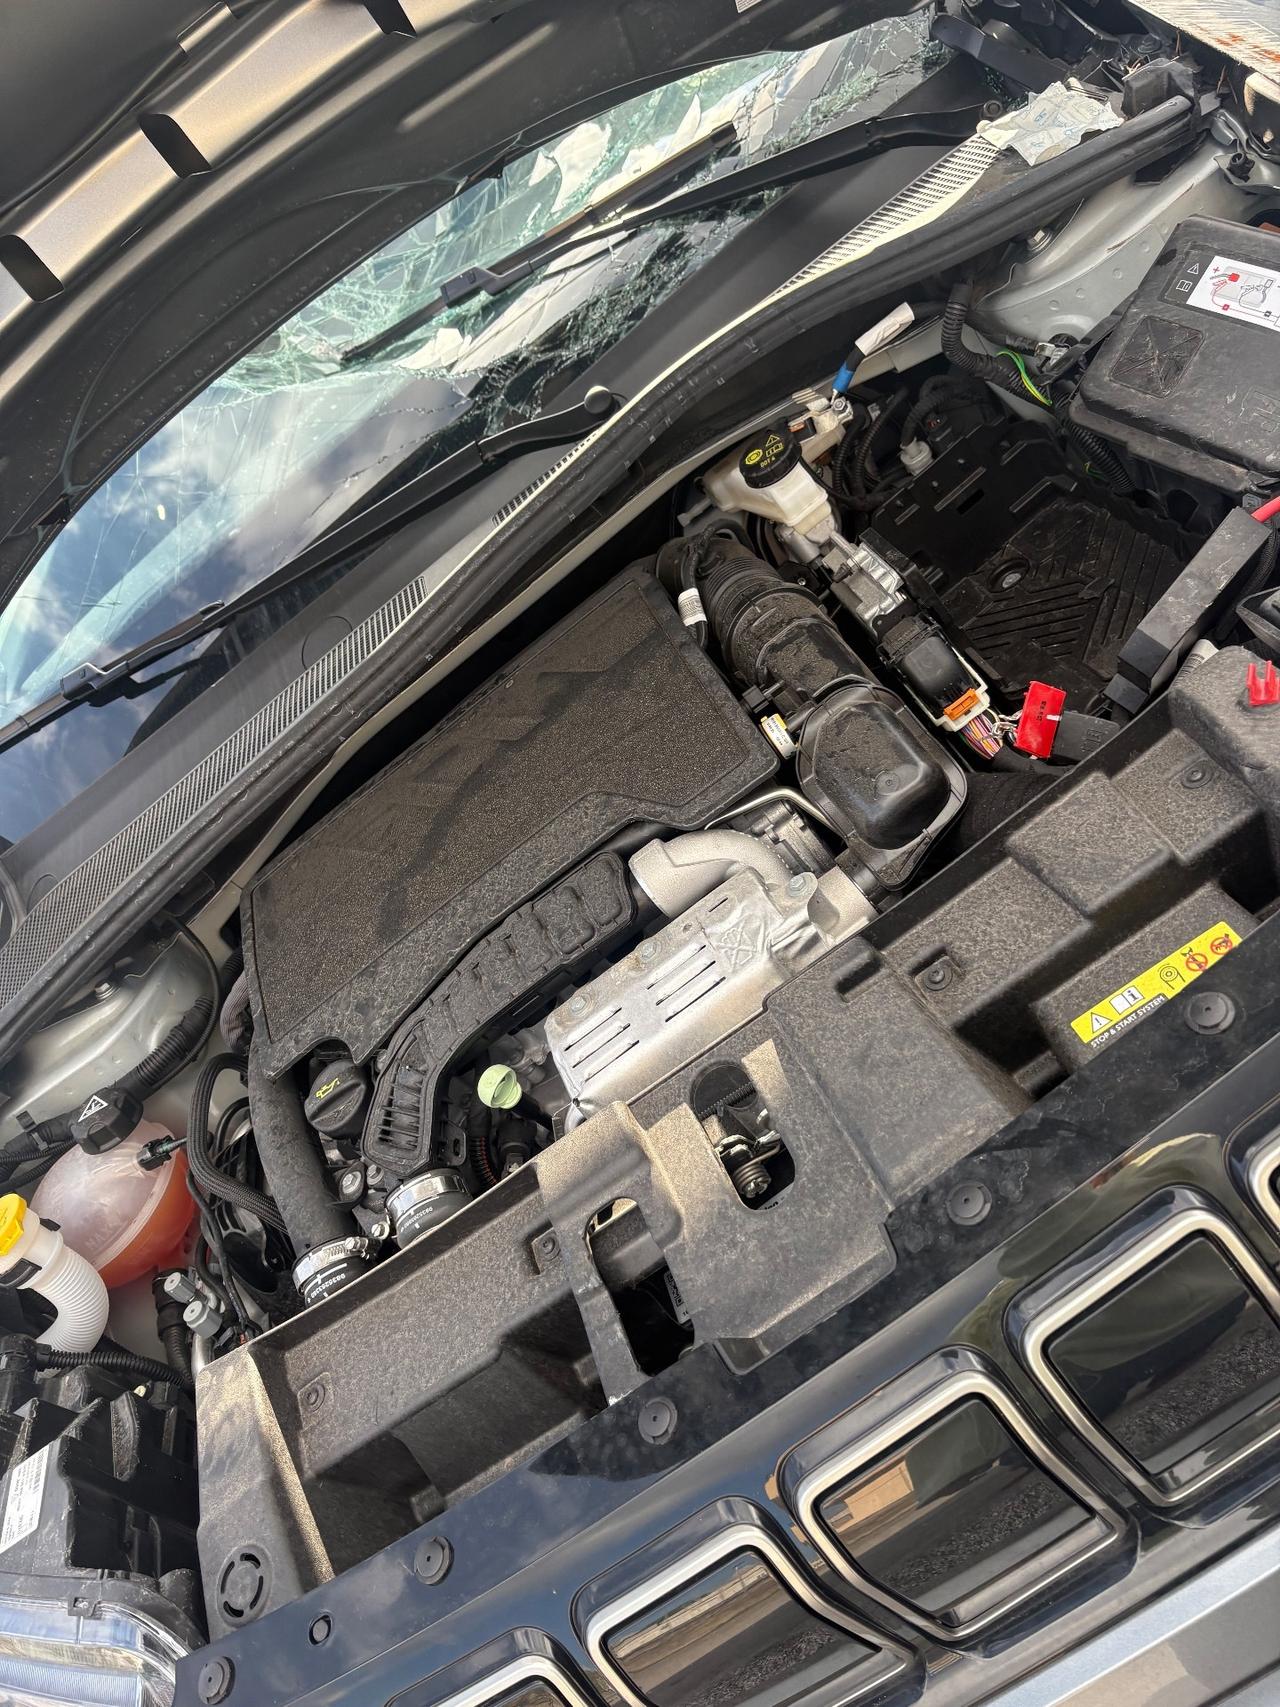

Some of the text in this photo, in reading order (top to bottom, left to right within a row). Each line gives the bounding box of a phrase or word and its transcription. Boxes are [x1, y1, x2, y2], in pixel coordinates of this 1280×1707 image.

[1090, 995, 1166, 1048] STOP & START SYSTEM
